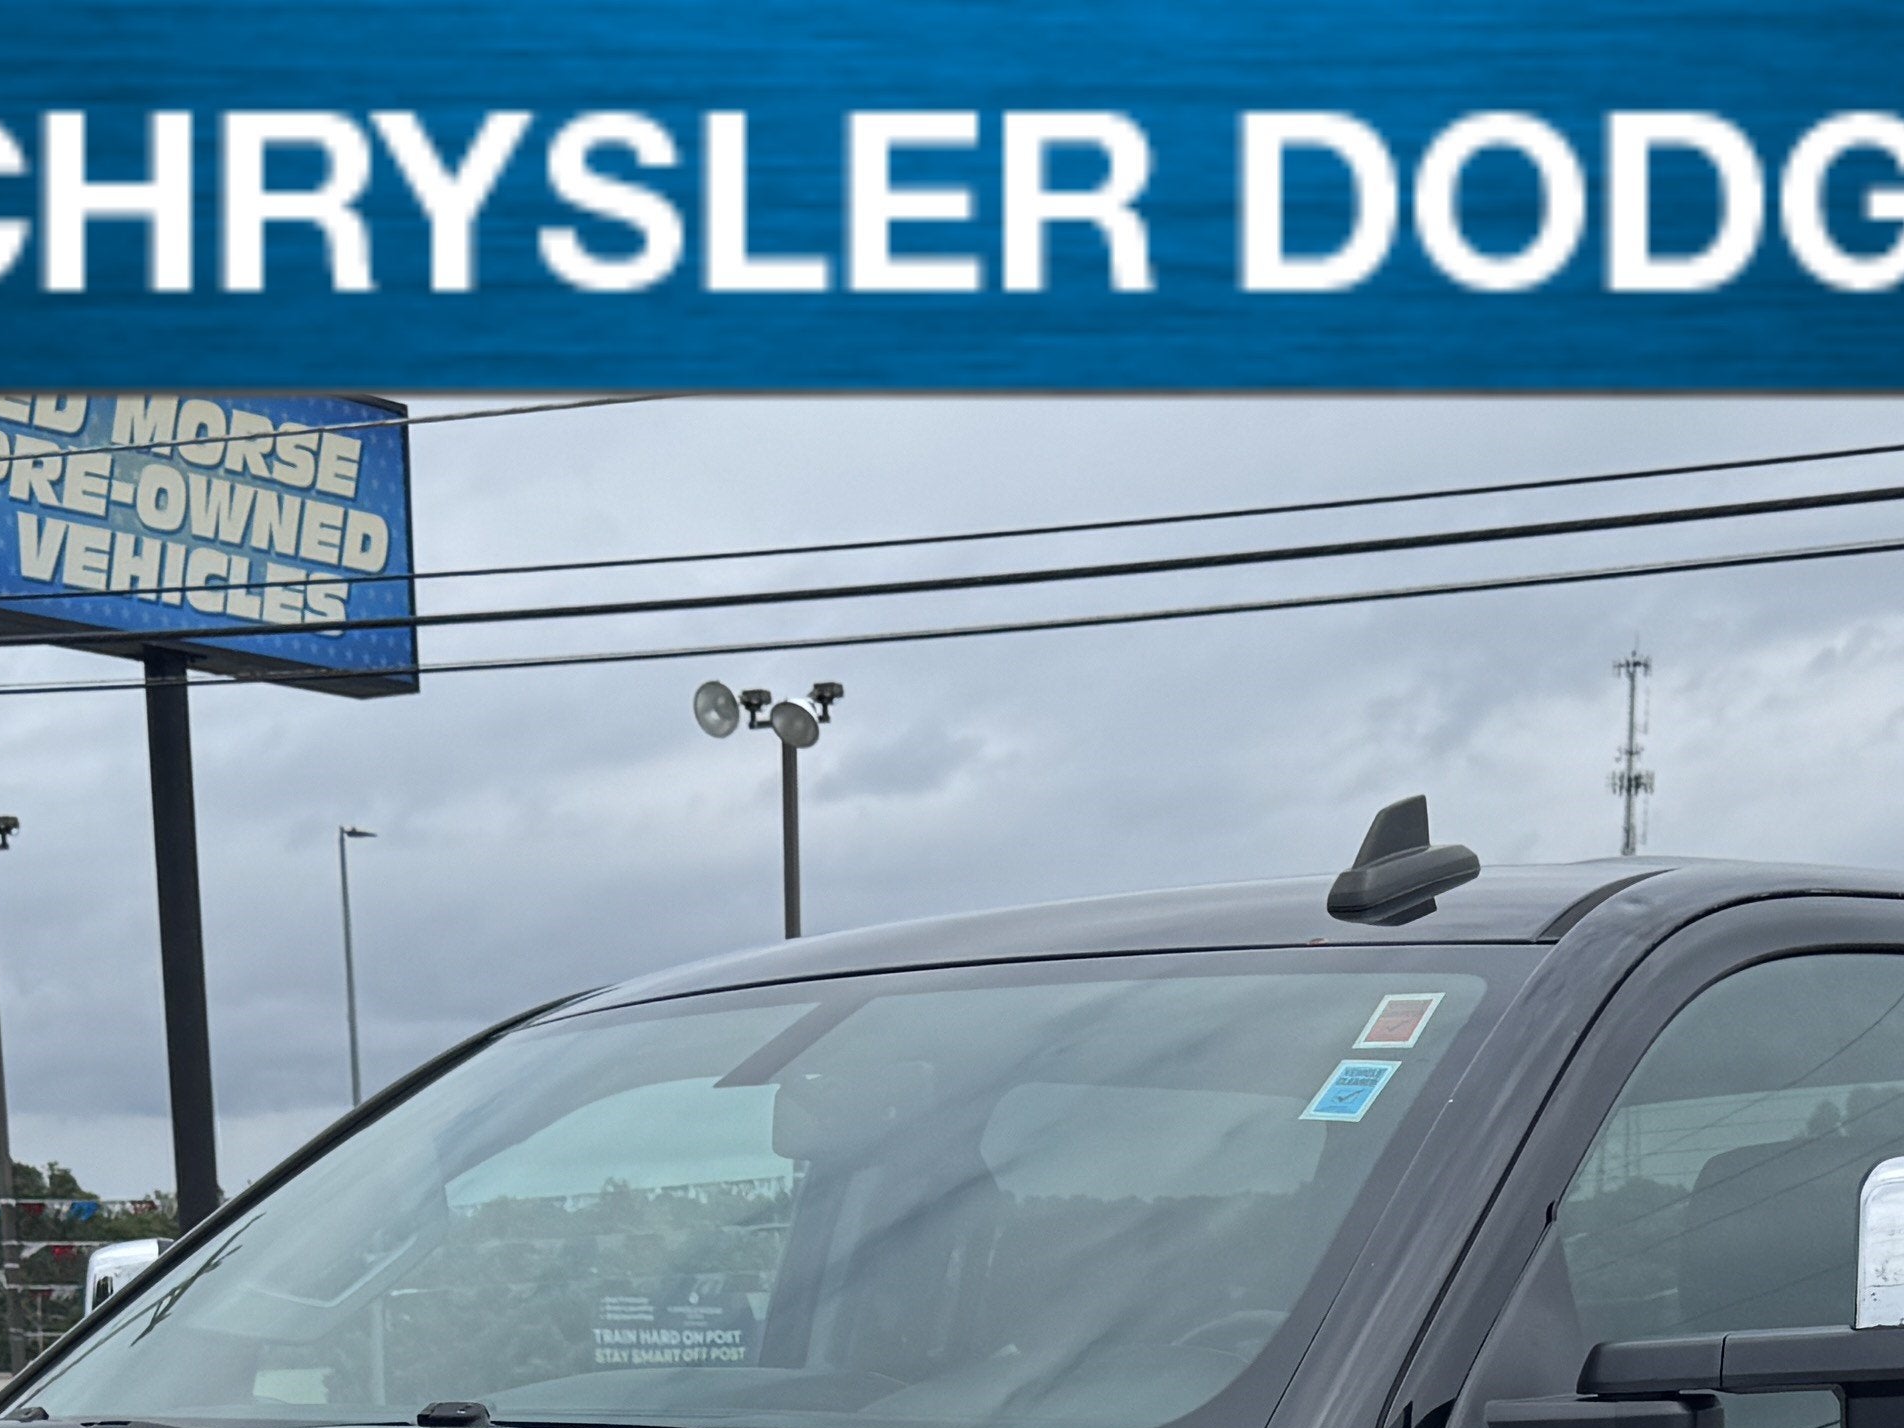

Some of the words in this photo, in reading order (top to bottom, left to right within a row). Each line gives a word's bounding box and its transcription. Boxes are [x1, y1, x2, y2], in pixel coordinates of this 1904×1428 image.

[109, 394, 363, 499] MORSE
[15, 511, 353, 638] VEHICLES
[592, 1328, 638, 1345] TRAIN
[638, 1329, 681, 1345] HARD
[682, 1330, 704, 1345] ON
[705, 1329, 743, 1345] POST
[594, 1347, 630, 1364] STAY
[632, 1347, 681, 1364] SMART
[710, 1346, 747, 1362] POST
